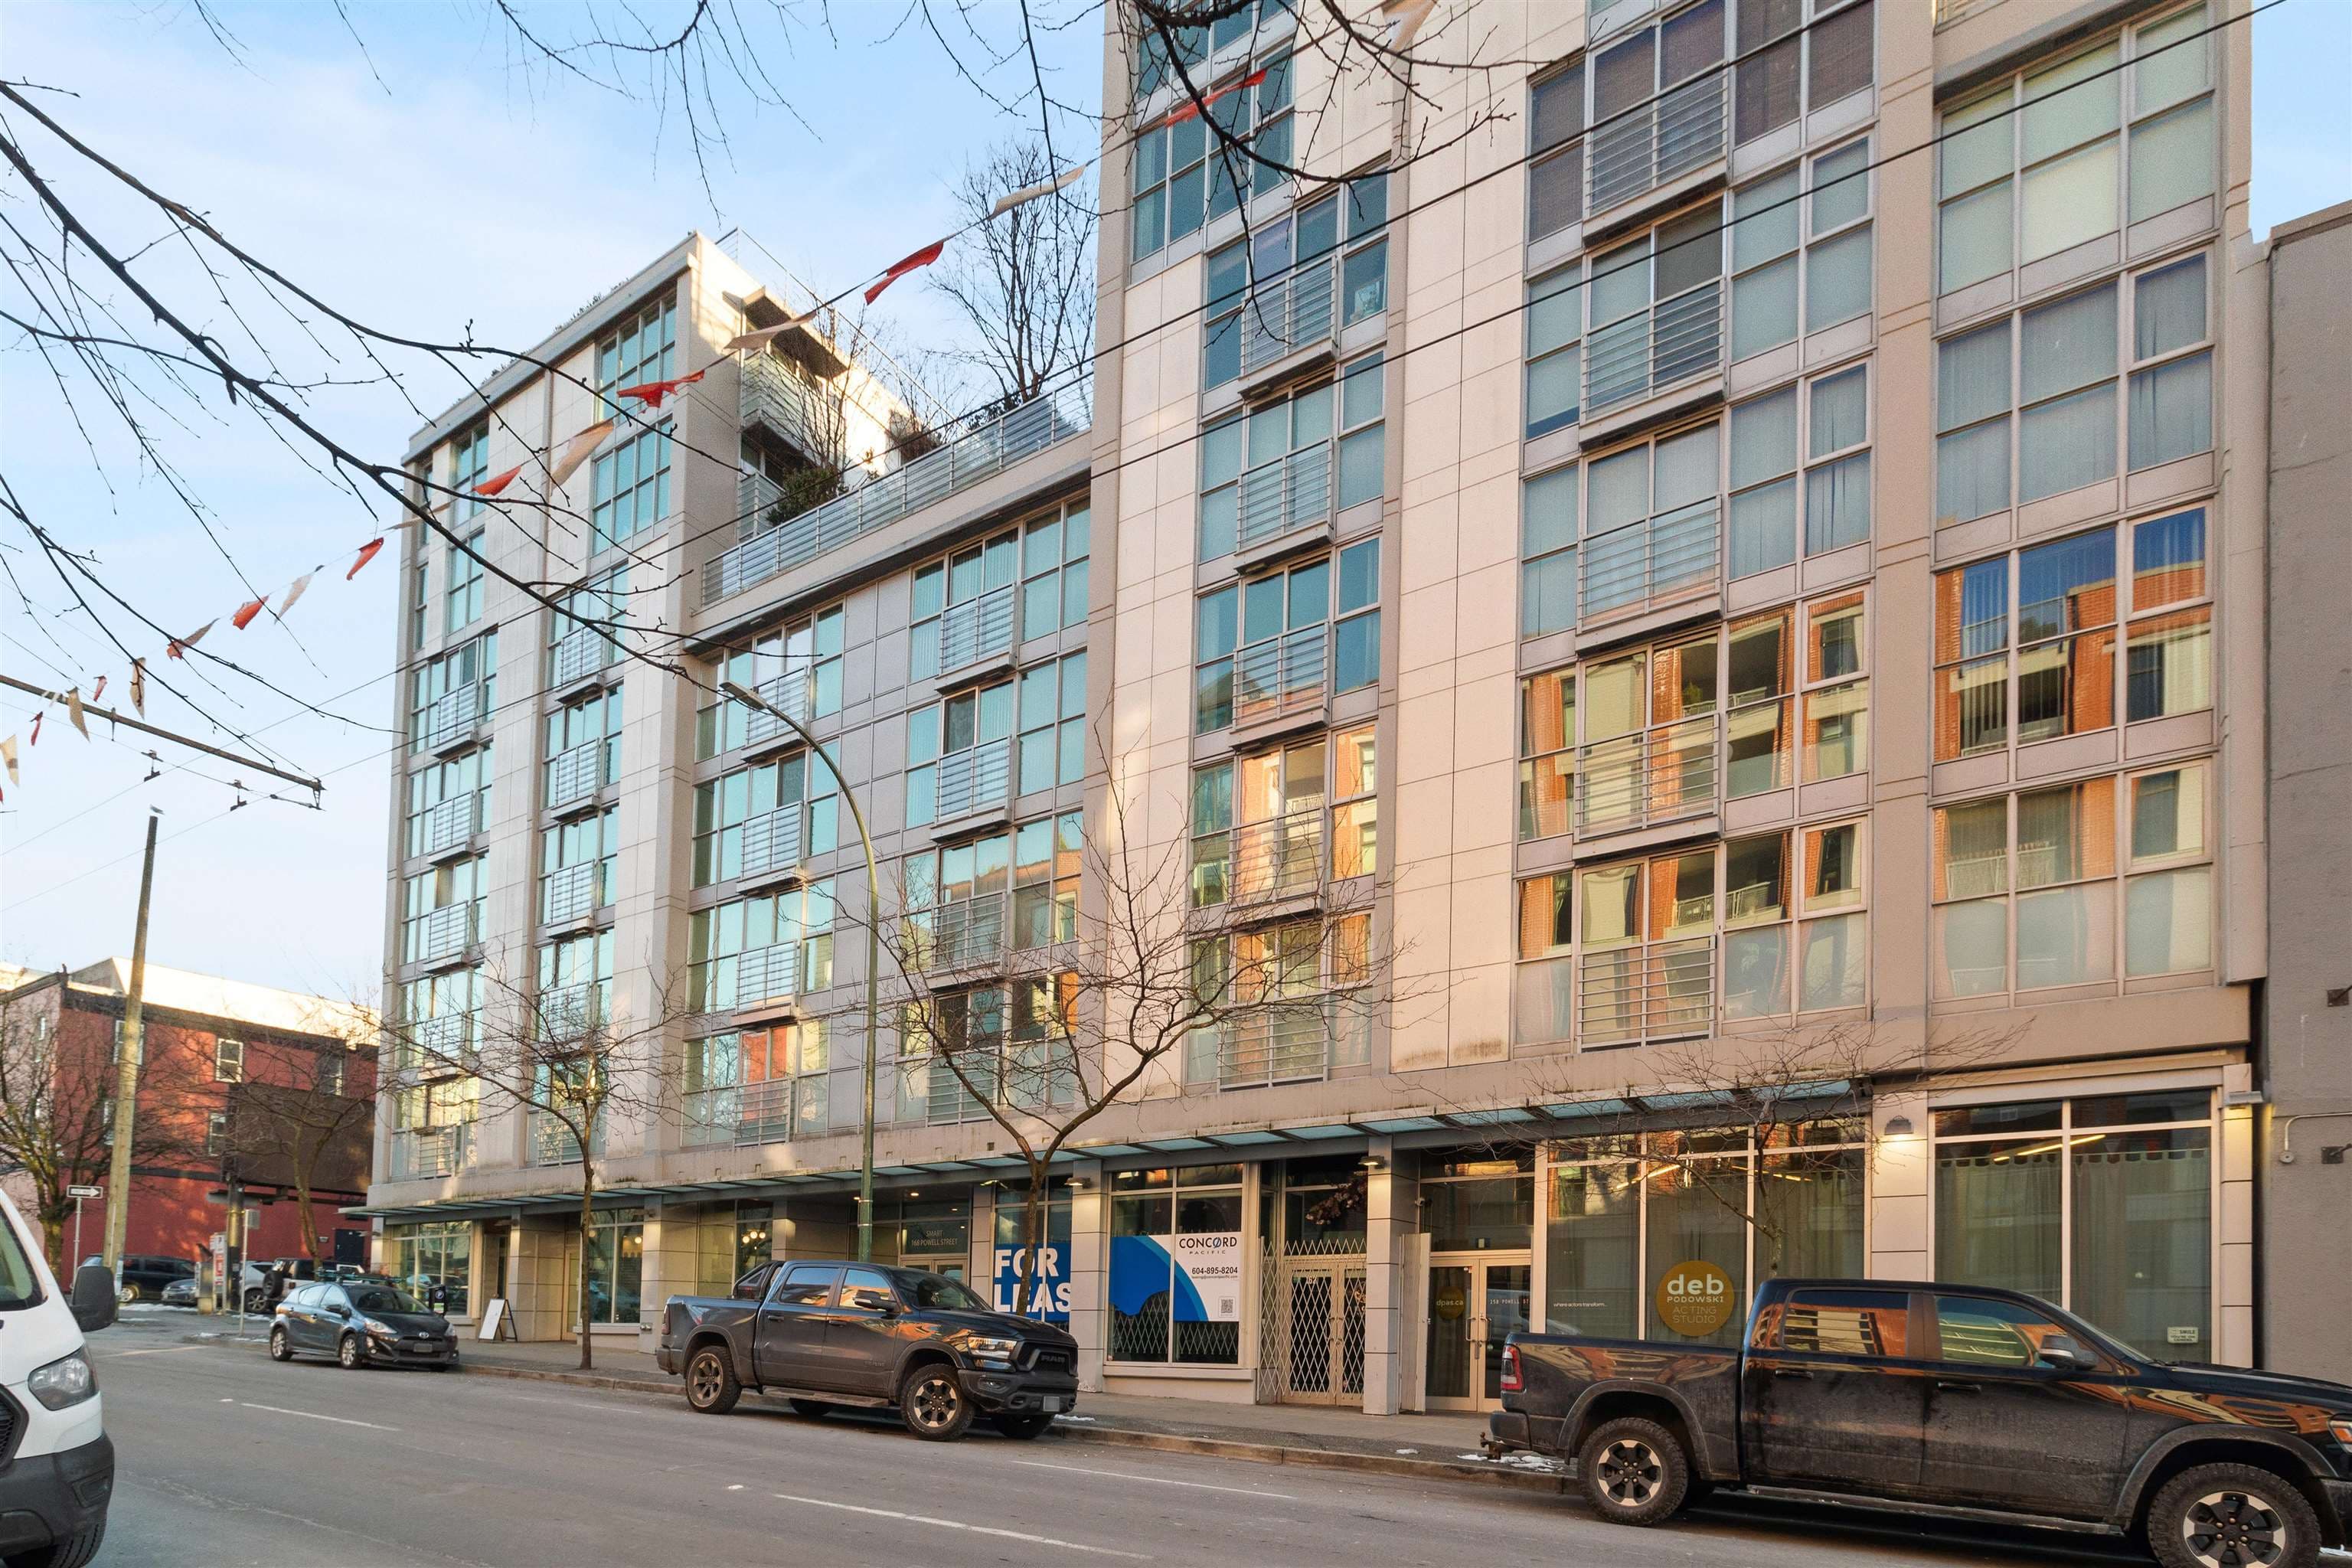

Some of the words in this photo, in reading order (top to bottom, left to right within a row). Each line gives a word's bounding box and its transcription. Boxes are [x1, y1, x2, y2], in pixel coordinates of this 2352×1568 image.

[995, 1247, 1059, 1278] FOR
[1667, 1273, 1724, 1295] deb
[1672, 1306, 1717, 1315] ACTING
[1672, 1315, 1717, 1324] STUDIO
